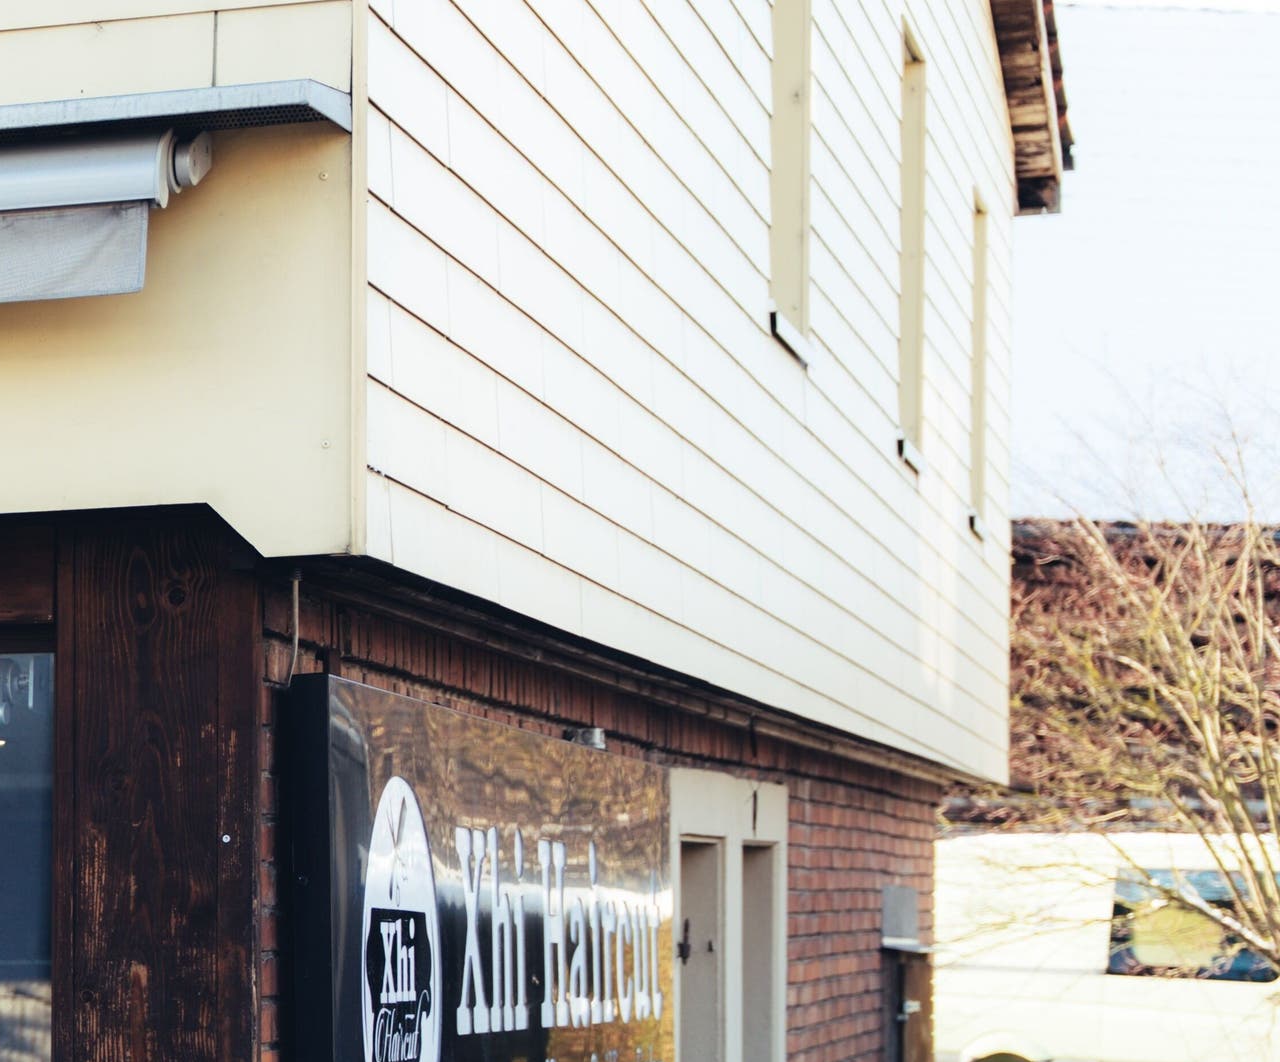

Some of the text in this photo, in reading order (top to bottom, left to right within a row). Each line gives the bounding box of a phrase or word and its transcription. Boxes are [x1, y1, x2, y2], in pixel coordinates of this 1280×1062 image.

[380, 917, 417, 1004] Xhi
[455, 826, 663, 1036] Xhi Haircut
